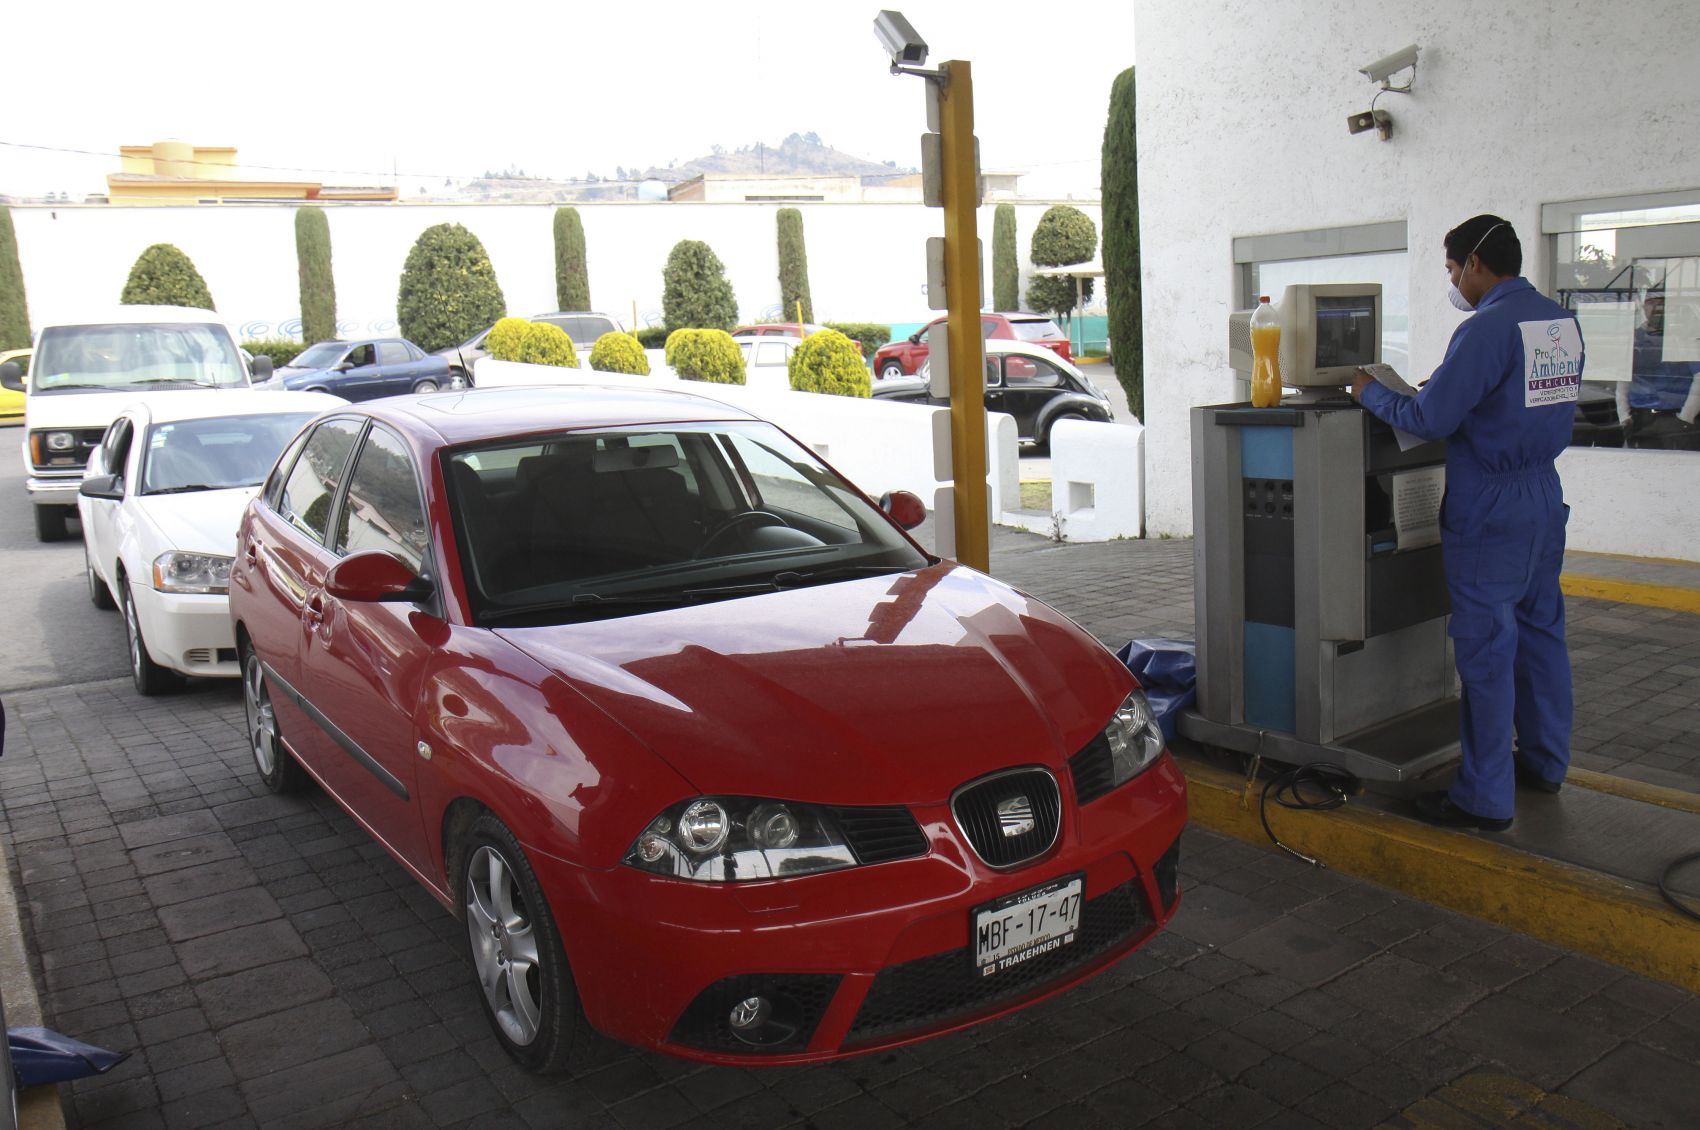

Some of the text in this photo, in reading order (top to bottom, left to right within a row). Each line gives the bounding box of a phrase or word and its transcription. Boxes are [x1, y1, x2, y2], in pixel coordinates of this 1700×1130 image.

[1534, 348, 1549, 360] Pro
[978, 892, 1081, 955] MBF-17-47
[998, 937, 1061, 970] TRAKEHNEN
